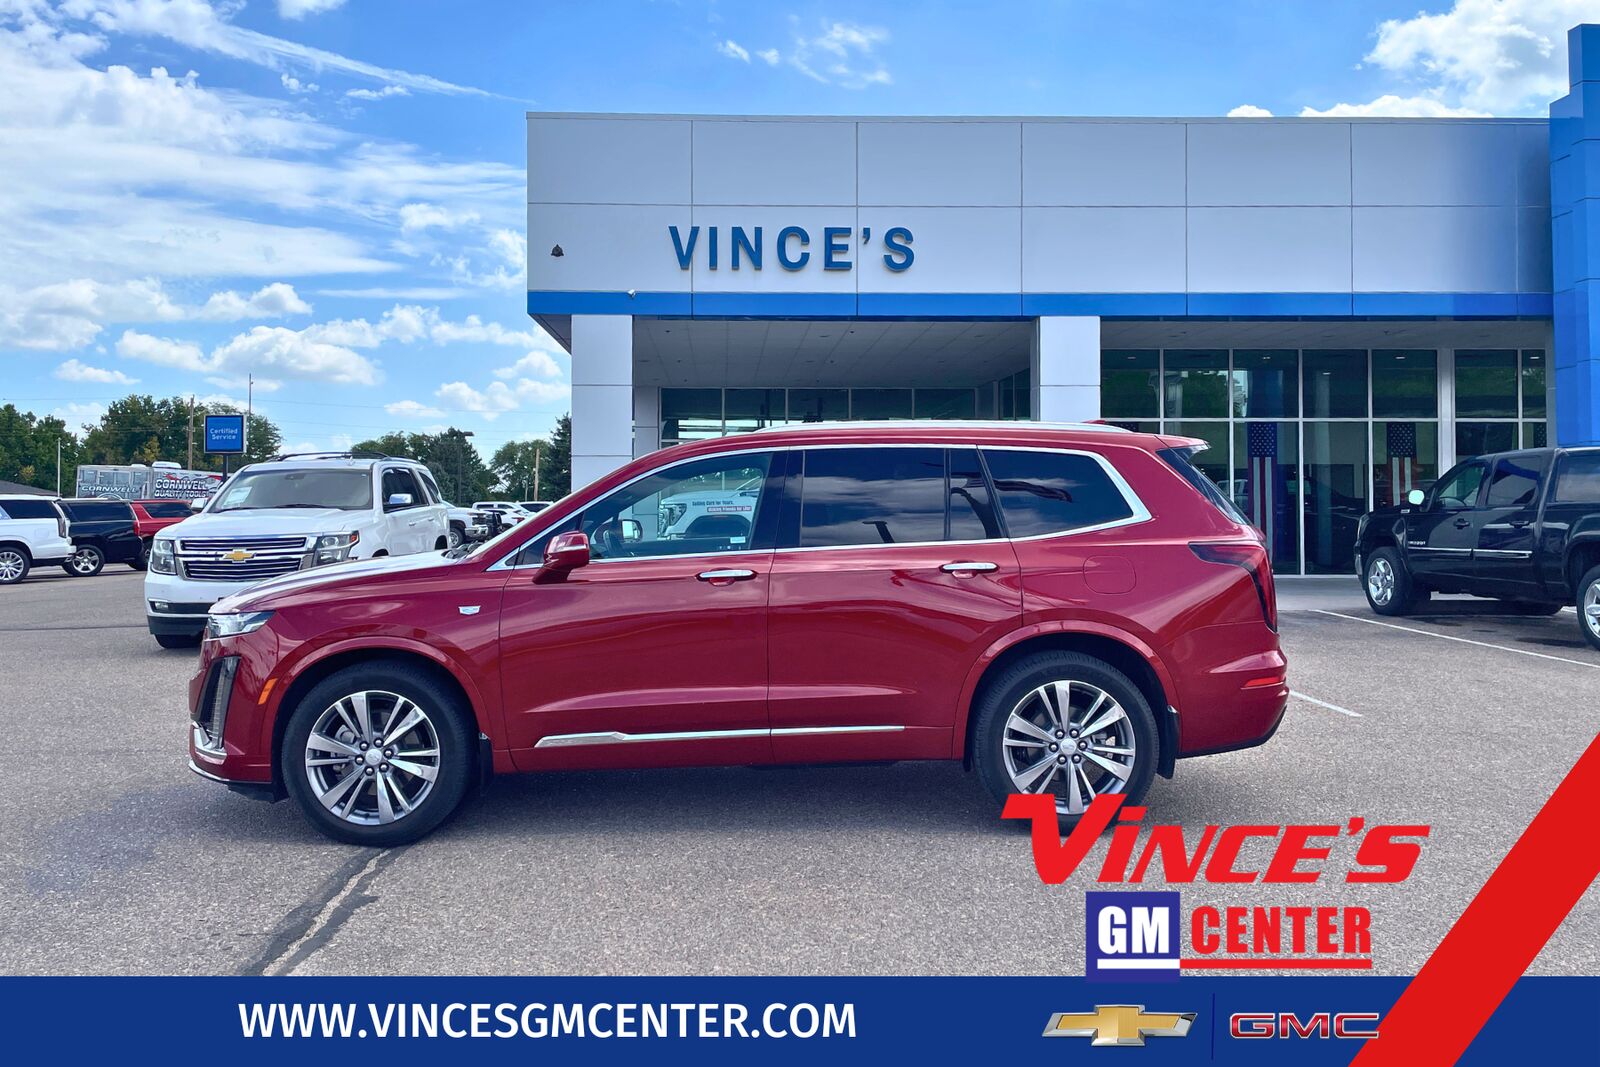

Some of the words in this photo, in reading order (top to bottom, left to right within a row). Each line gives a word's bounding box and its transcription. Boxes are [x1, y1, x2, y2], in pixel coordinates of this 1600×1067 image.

[668, 225, 915, 272] VINCE'S
[81, 485, 137, 493] CORNWELL
[155, 479, 208, 490] CORNWELL
[154, 490, 184, 498] QUALITY
[186, 490, 207, 498] TOOLS
